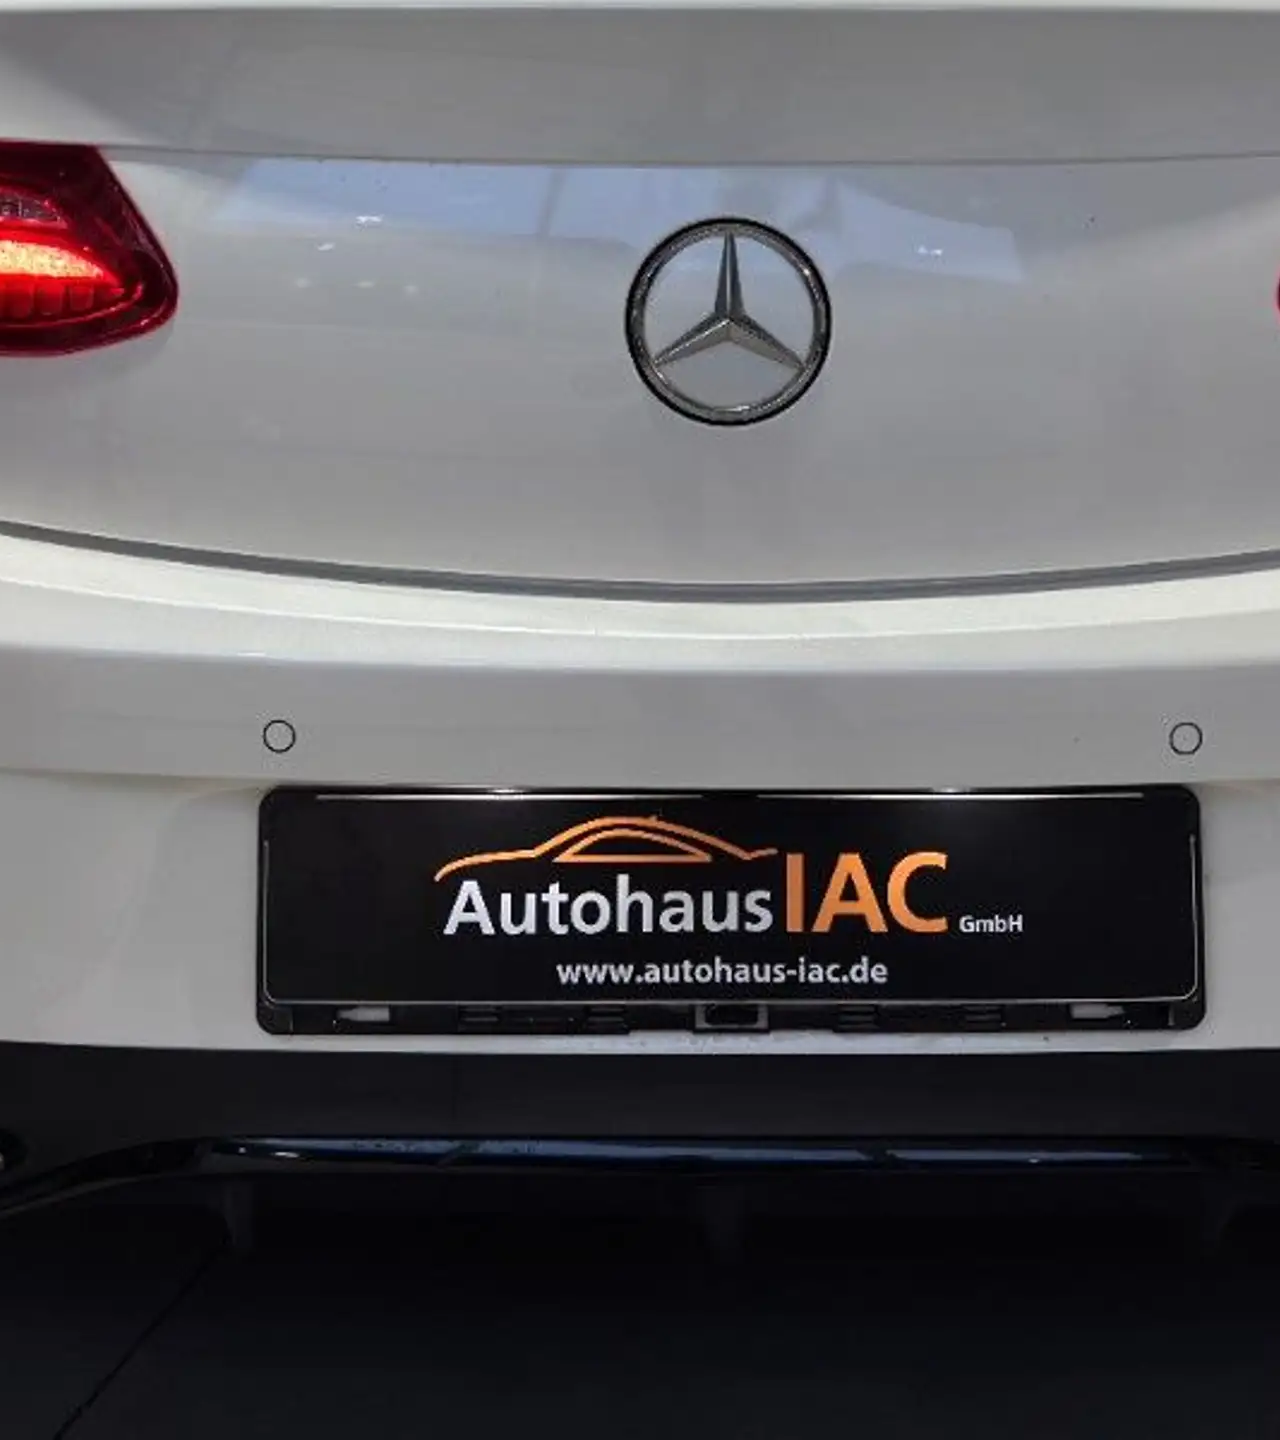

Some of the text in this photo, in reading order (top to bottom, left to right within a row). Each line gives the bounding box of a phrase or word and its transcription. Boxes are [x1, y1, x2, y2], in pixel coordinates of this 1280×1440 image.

[443, 851, 1023, 935] Autohaus IAC GmbH
[556, 957, 888, 985] www.autohaus-iac.de
